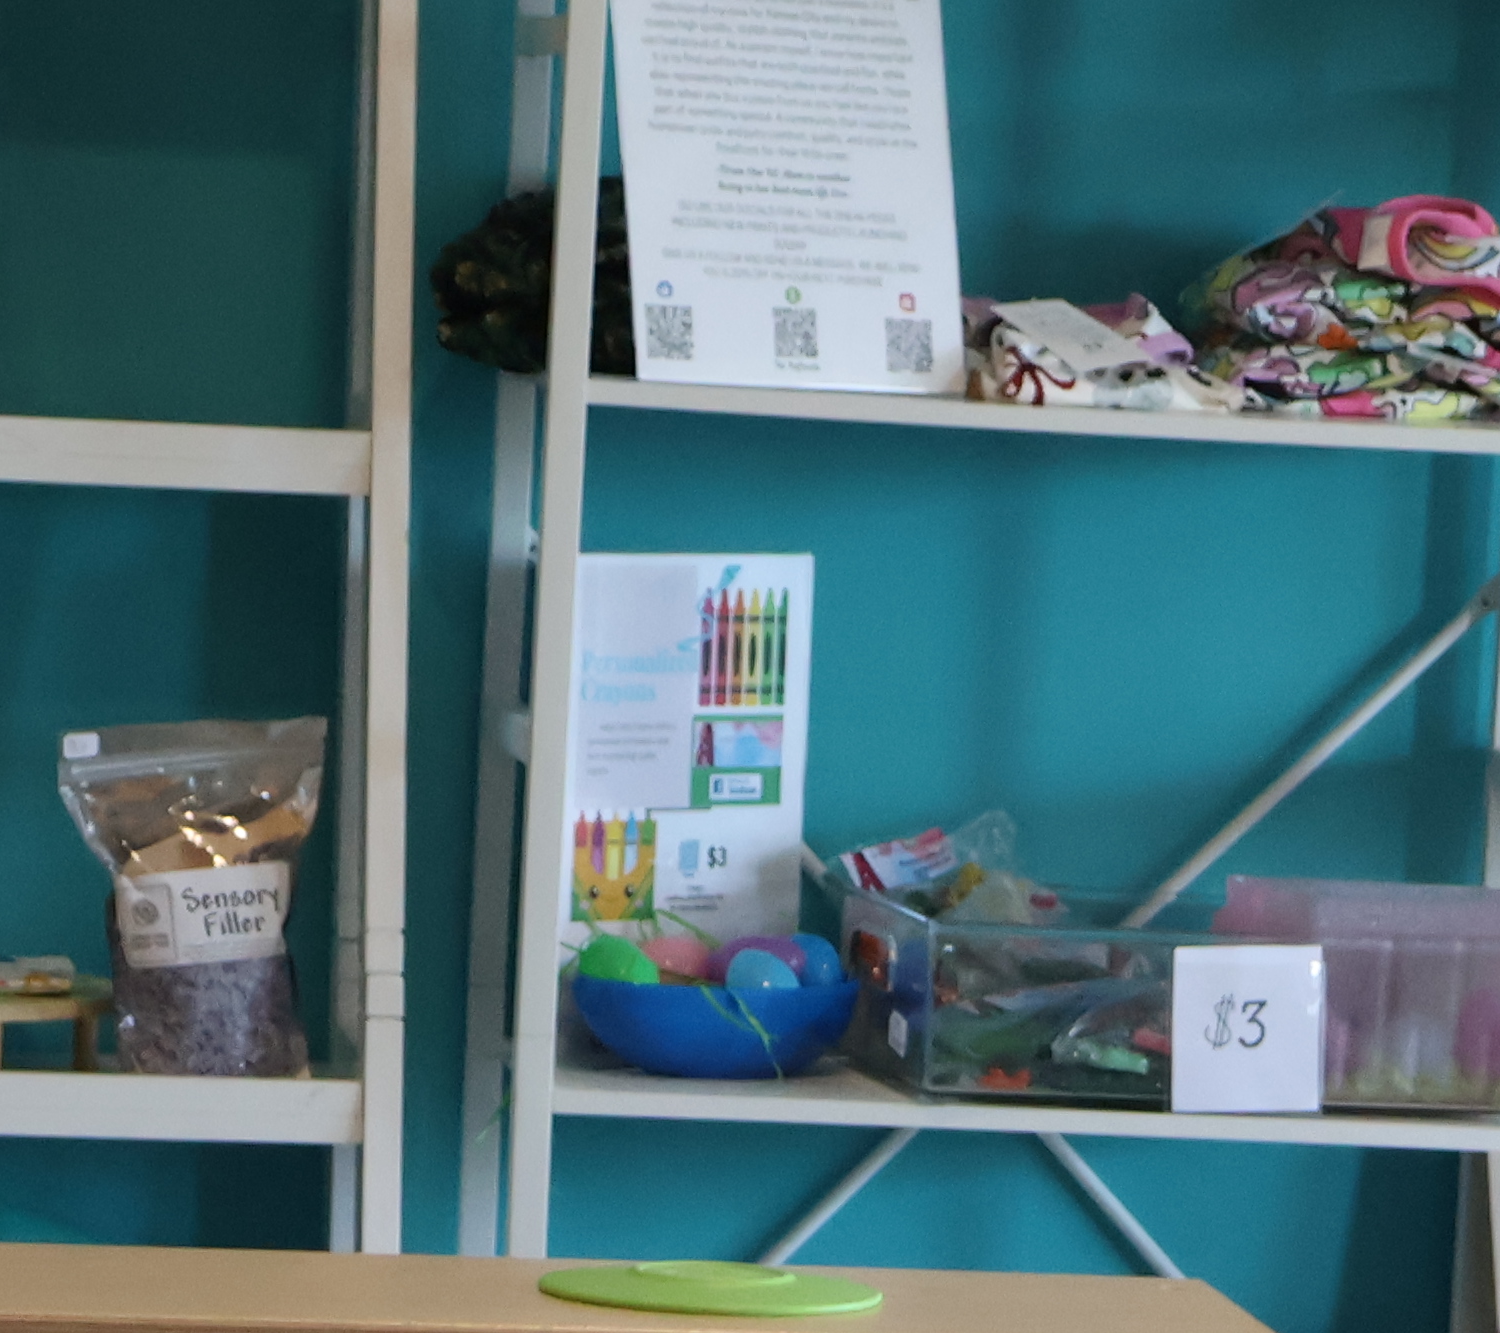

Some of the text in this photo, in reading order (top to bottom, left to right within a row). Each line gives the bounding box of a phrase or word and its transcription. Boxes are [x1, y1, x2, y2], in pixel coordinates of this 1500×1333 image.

[706, 845, 727, 868] $3
[182, 886, 279, 912] Sensory
[204, 911, 266, 936] Filler
[1205, 994, 1268, 1049] $3
